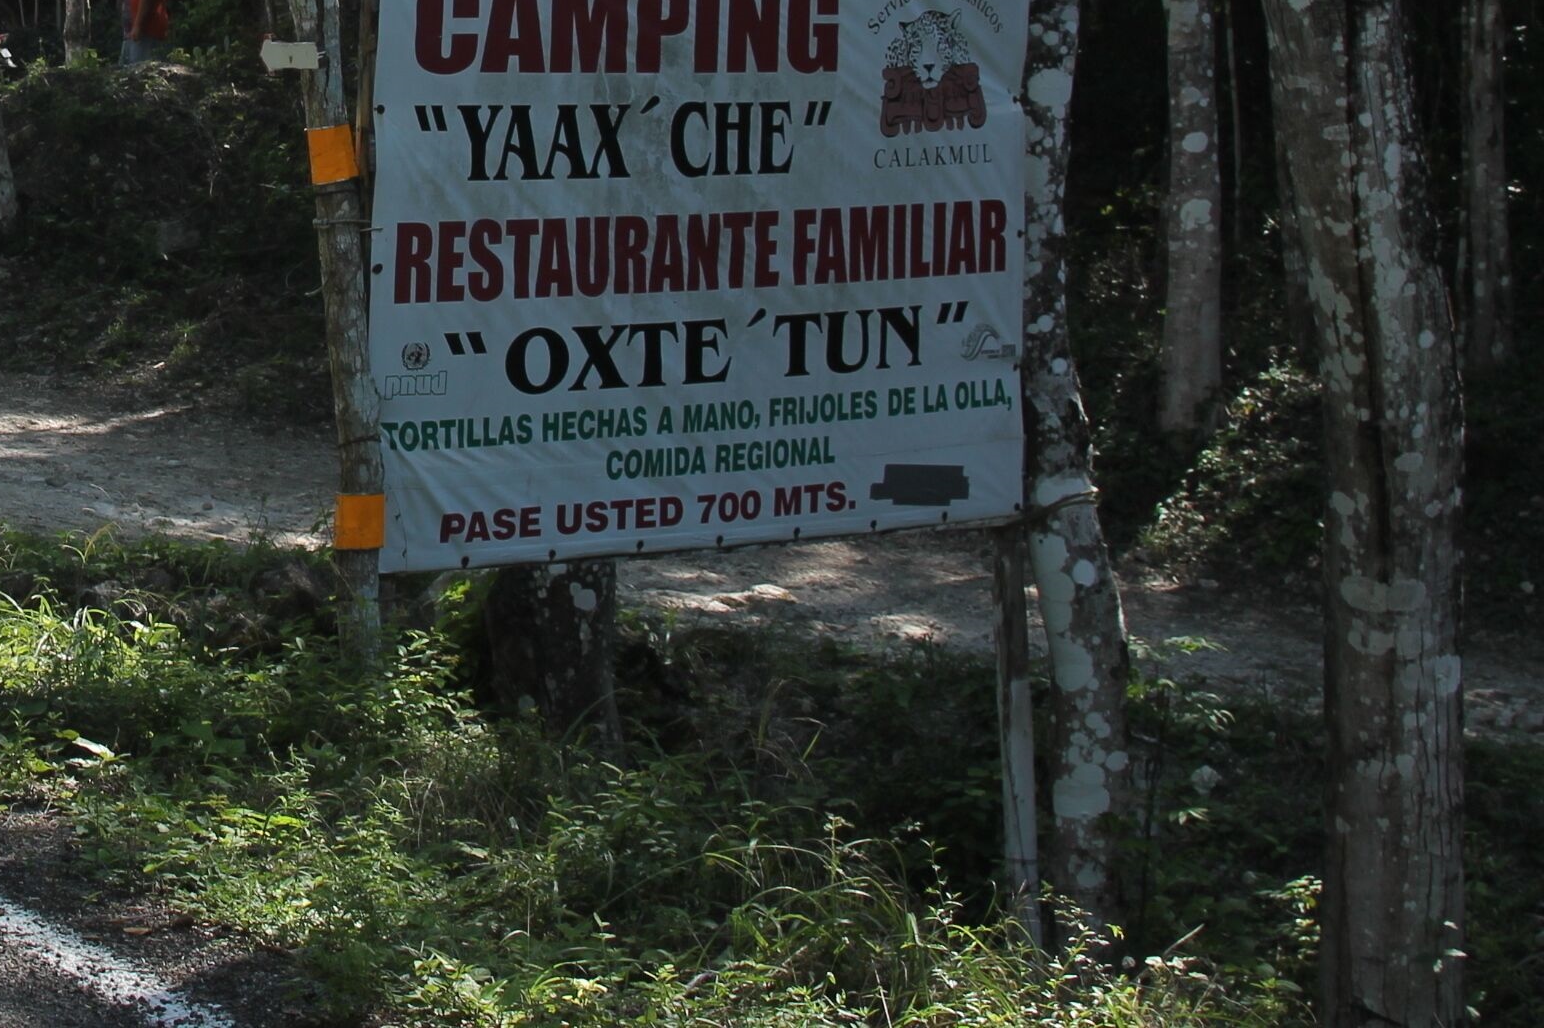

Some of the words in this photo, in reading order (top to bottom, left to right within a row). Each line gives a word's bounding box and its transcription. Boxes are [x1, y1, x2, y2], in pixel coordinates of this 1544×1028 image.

[873, 143, 992, 169] CALAKMUL
[393, 210, 780, 305] RESTAURANTE
[792, 199, 1007, 286] FAMILIAR
[384, 370, 448, 401] pnud
[380, 414, 533, 452] TORTILLAS
[542, 405, 647, 442] HECHAS
[657, 405, 673, 435] A
[683, 399, 760, 434] MANO,
[769, 390, 878, 427] FRIJOLES
[887, 386, 916, 417] DE
[923, 383, 948, 414] LA
[955, 378, 1012, 411] OLLA,
[606, 445, 706, 481] COMIDA
[715, 435, 836, 473] REGIONAL
[439, 506, 542, 544] PASE
[556, 496, 684, 535] USTED
[697, 489, 762, 524] 700
[773, 481, 856, 517] MTS.
